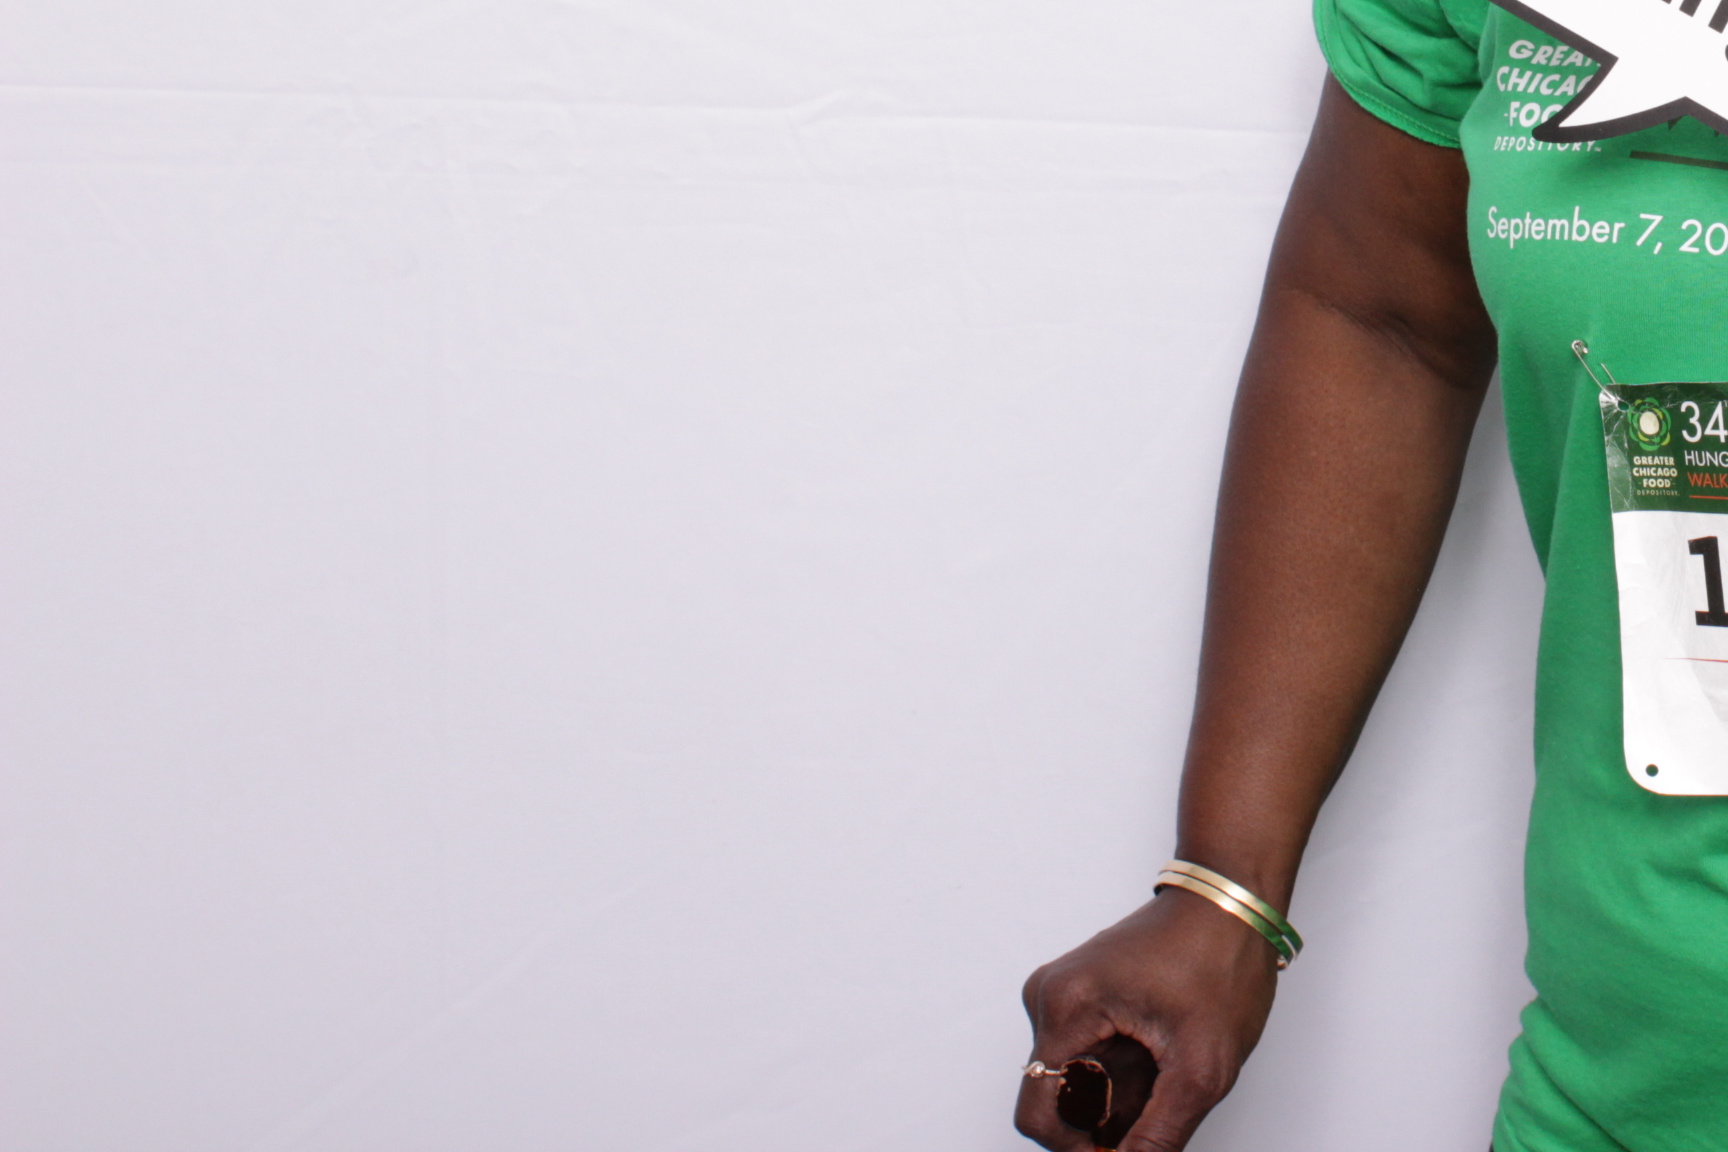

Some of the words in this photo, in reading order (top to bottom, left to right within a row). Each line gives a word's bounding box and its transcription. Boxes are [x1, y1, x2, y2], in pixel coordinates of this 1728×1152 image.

[1508, 39, 1602, 67] GREA
[1496, 65, 1594, 96] CHICA
[1487, 206, 1625, 249] September
[1636, 213, 1663, 255] 7,
[1632, 467, 1678, 477] CHICAGO
[1633, 456, 1675, 466] GREATER
